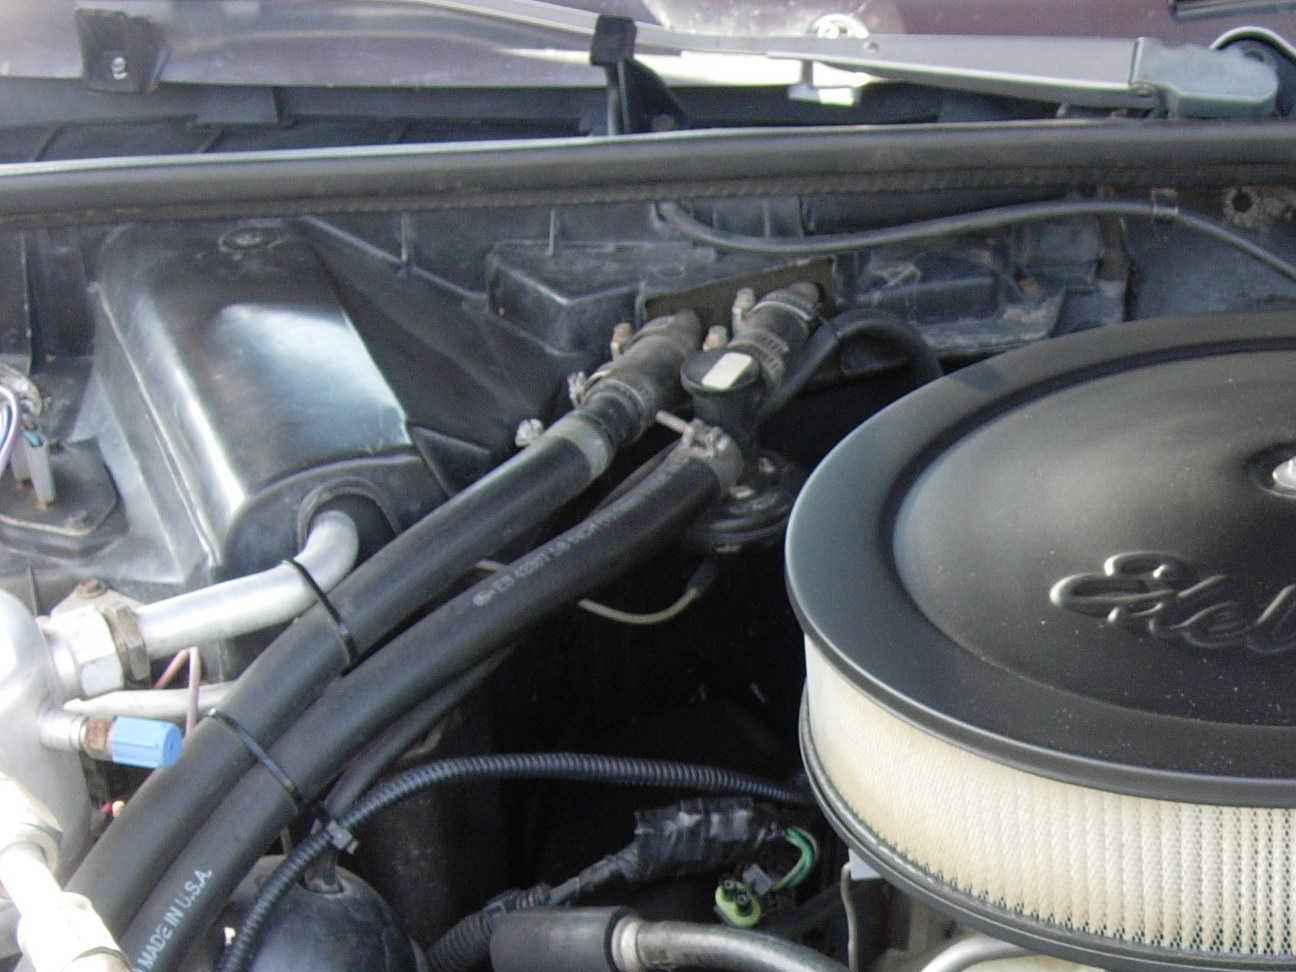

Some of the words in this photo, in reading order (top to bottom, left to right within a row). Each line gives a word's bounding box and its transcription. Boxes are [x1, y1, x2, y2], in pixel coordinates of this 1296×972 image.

[137, 924, 173, 969] MADE
[164, 905, 184, 928] IN
[175, 869, 213, 909] U.S.A.
